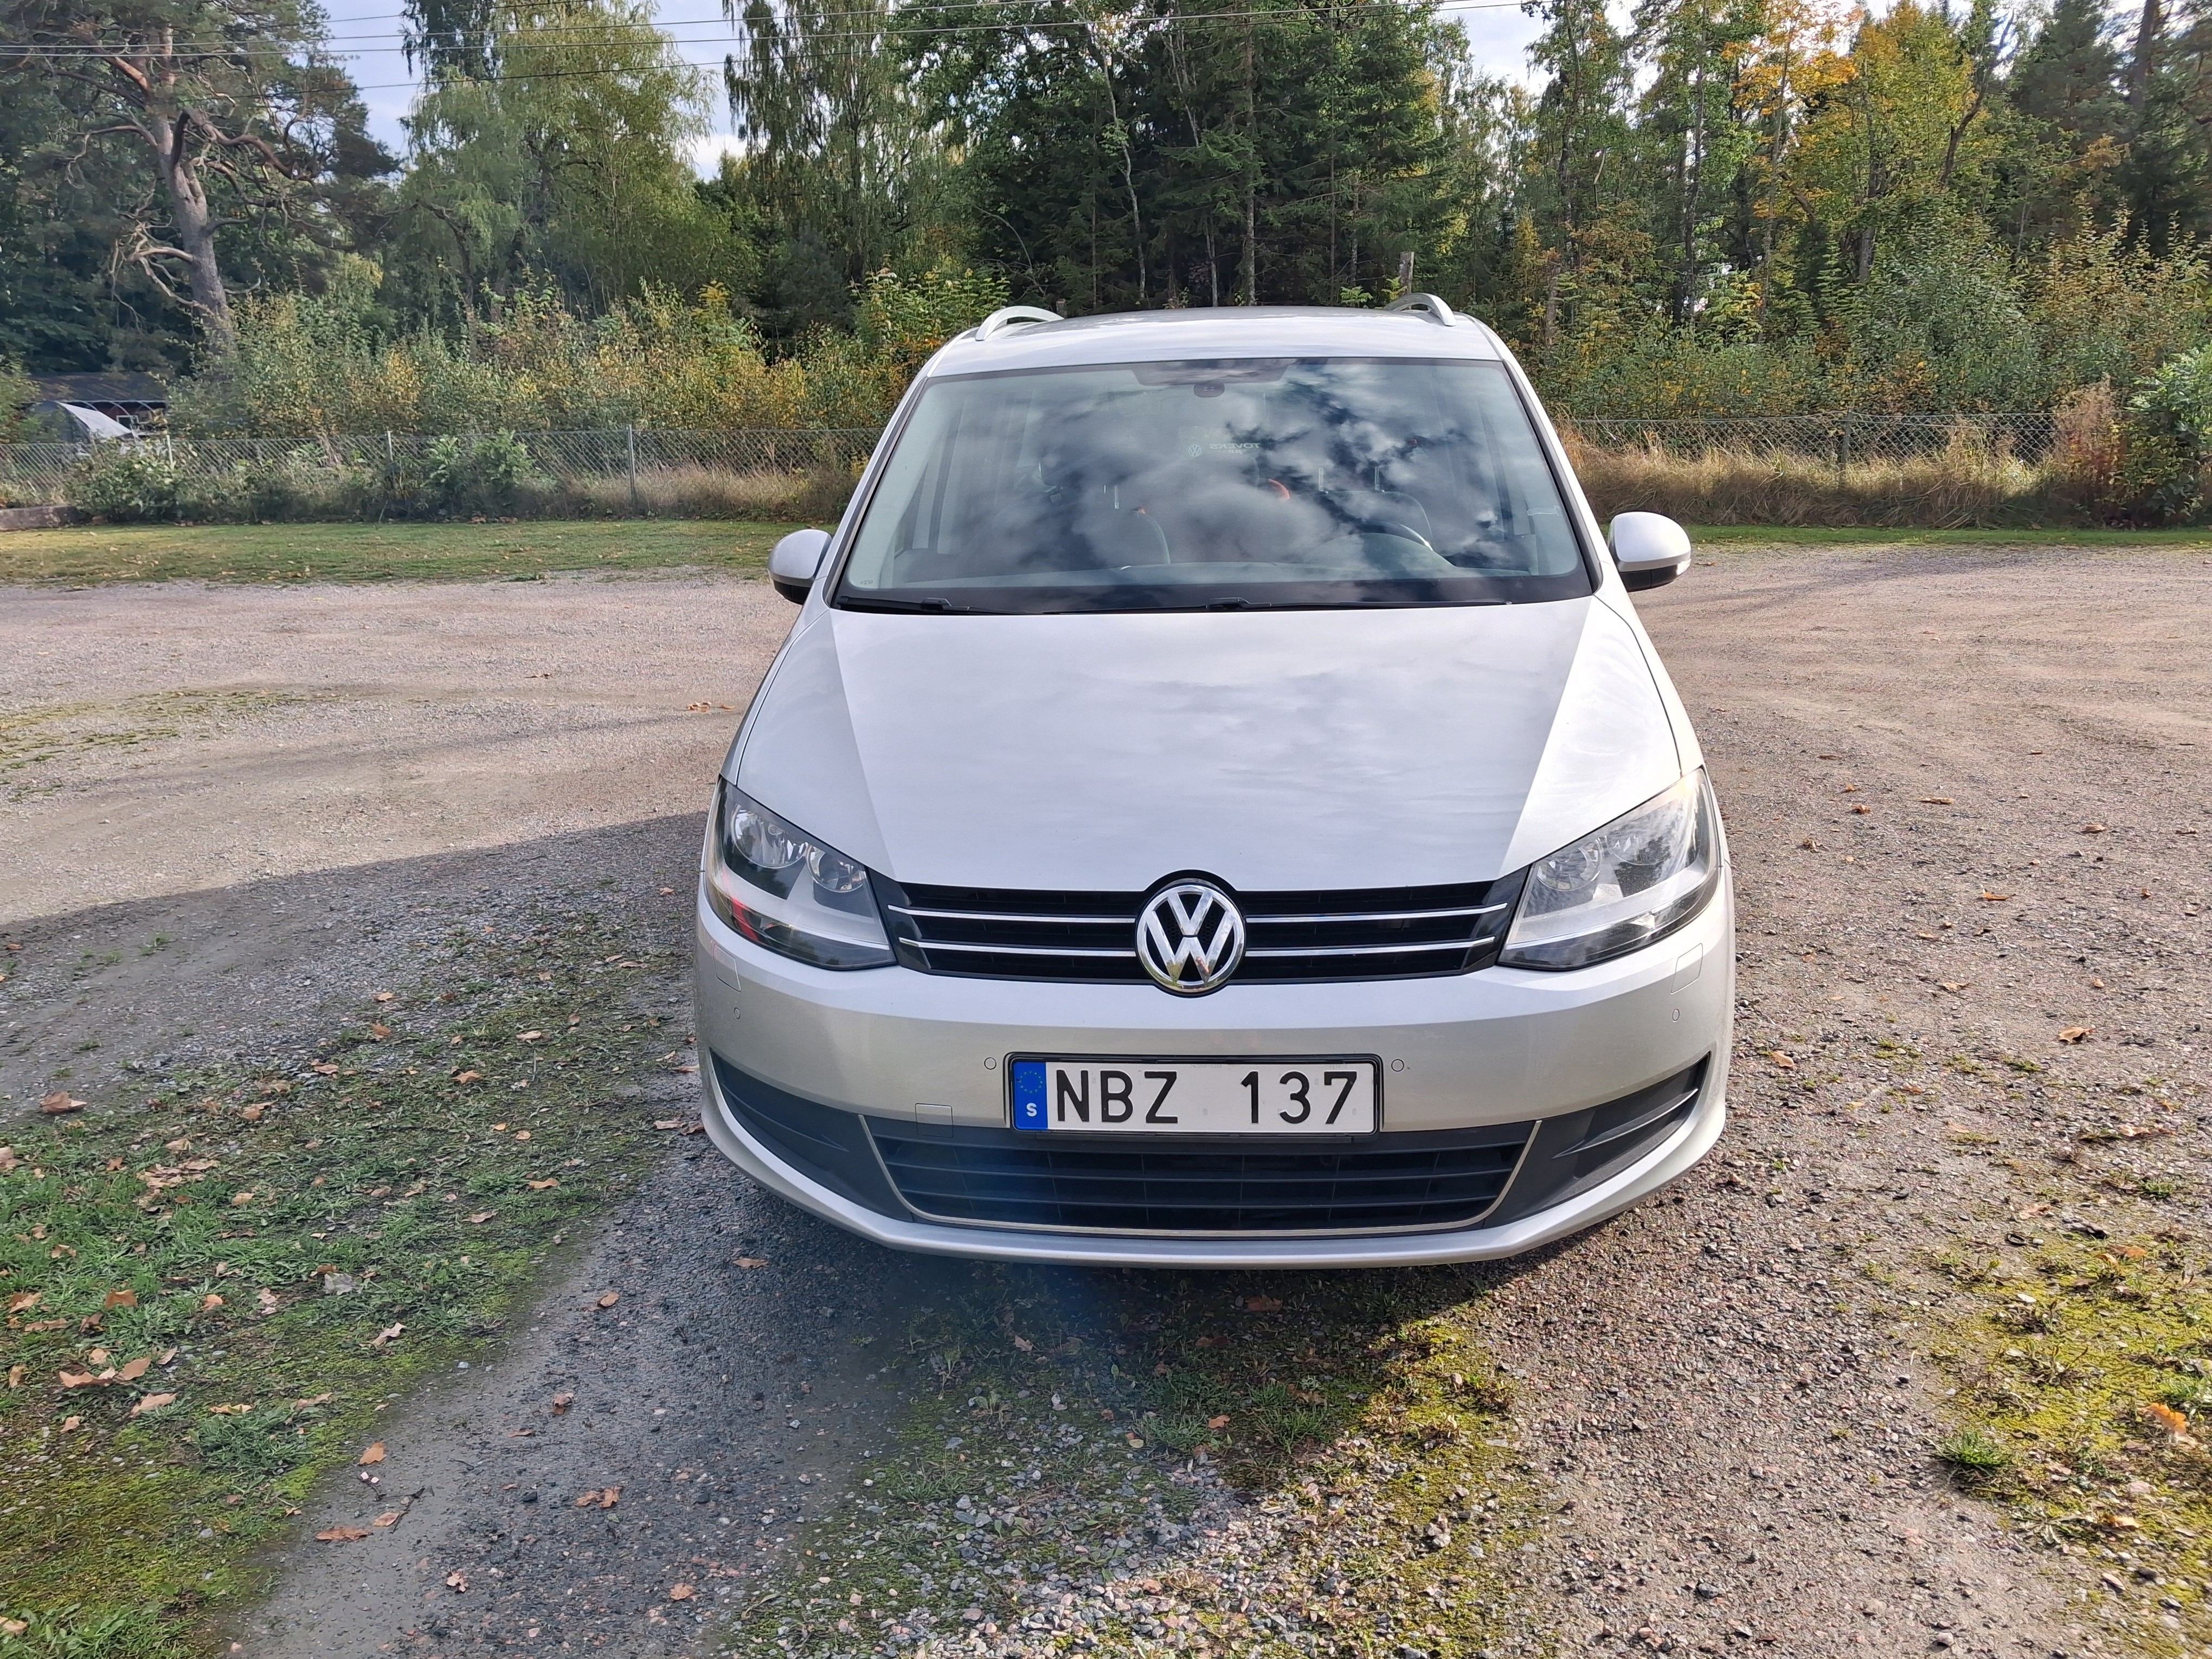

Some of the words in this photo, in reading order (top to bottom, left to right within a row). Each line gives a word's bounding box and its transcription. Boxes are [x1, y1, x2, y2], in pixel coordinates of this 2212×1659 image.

[1141, 888, 1240, 988] VW
[1026, 1102, 1038, 1117] S
[1056, 1069, 1179, 1124] NBZ
[1240, 1070, 1358, 1125] 137
